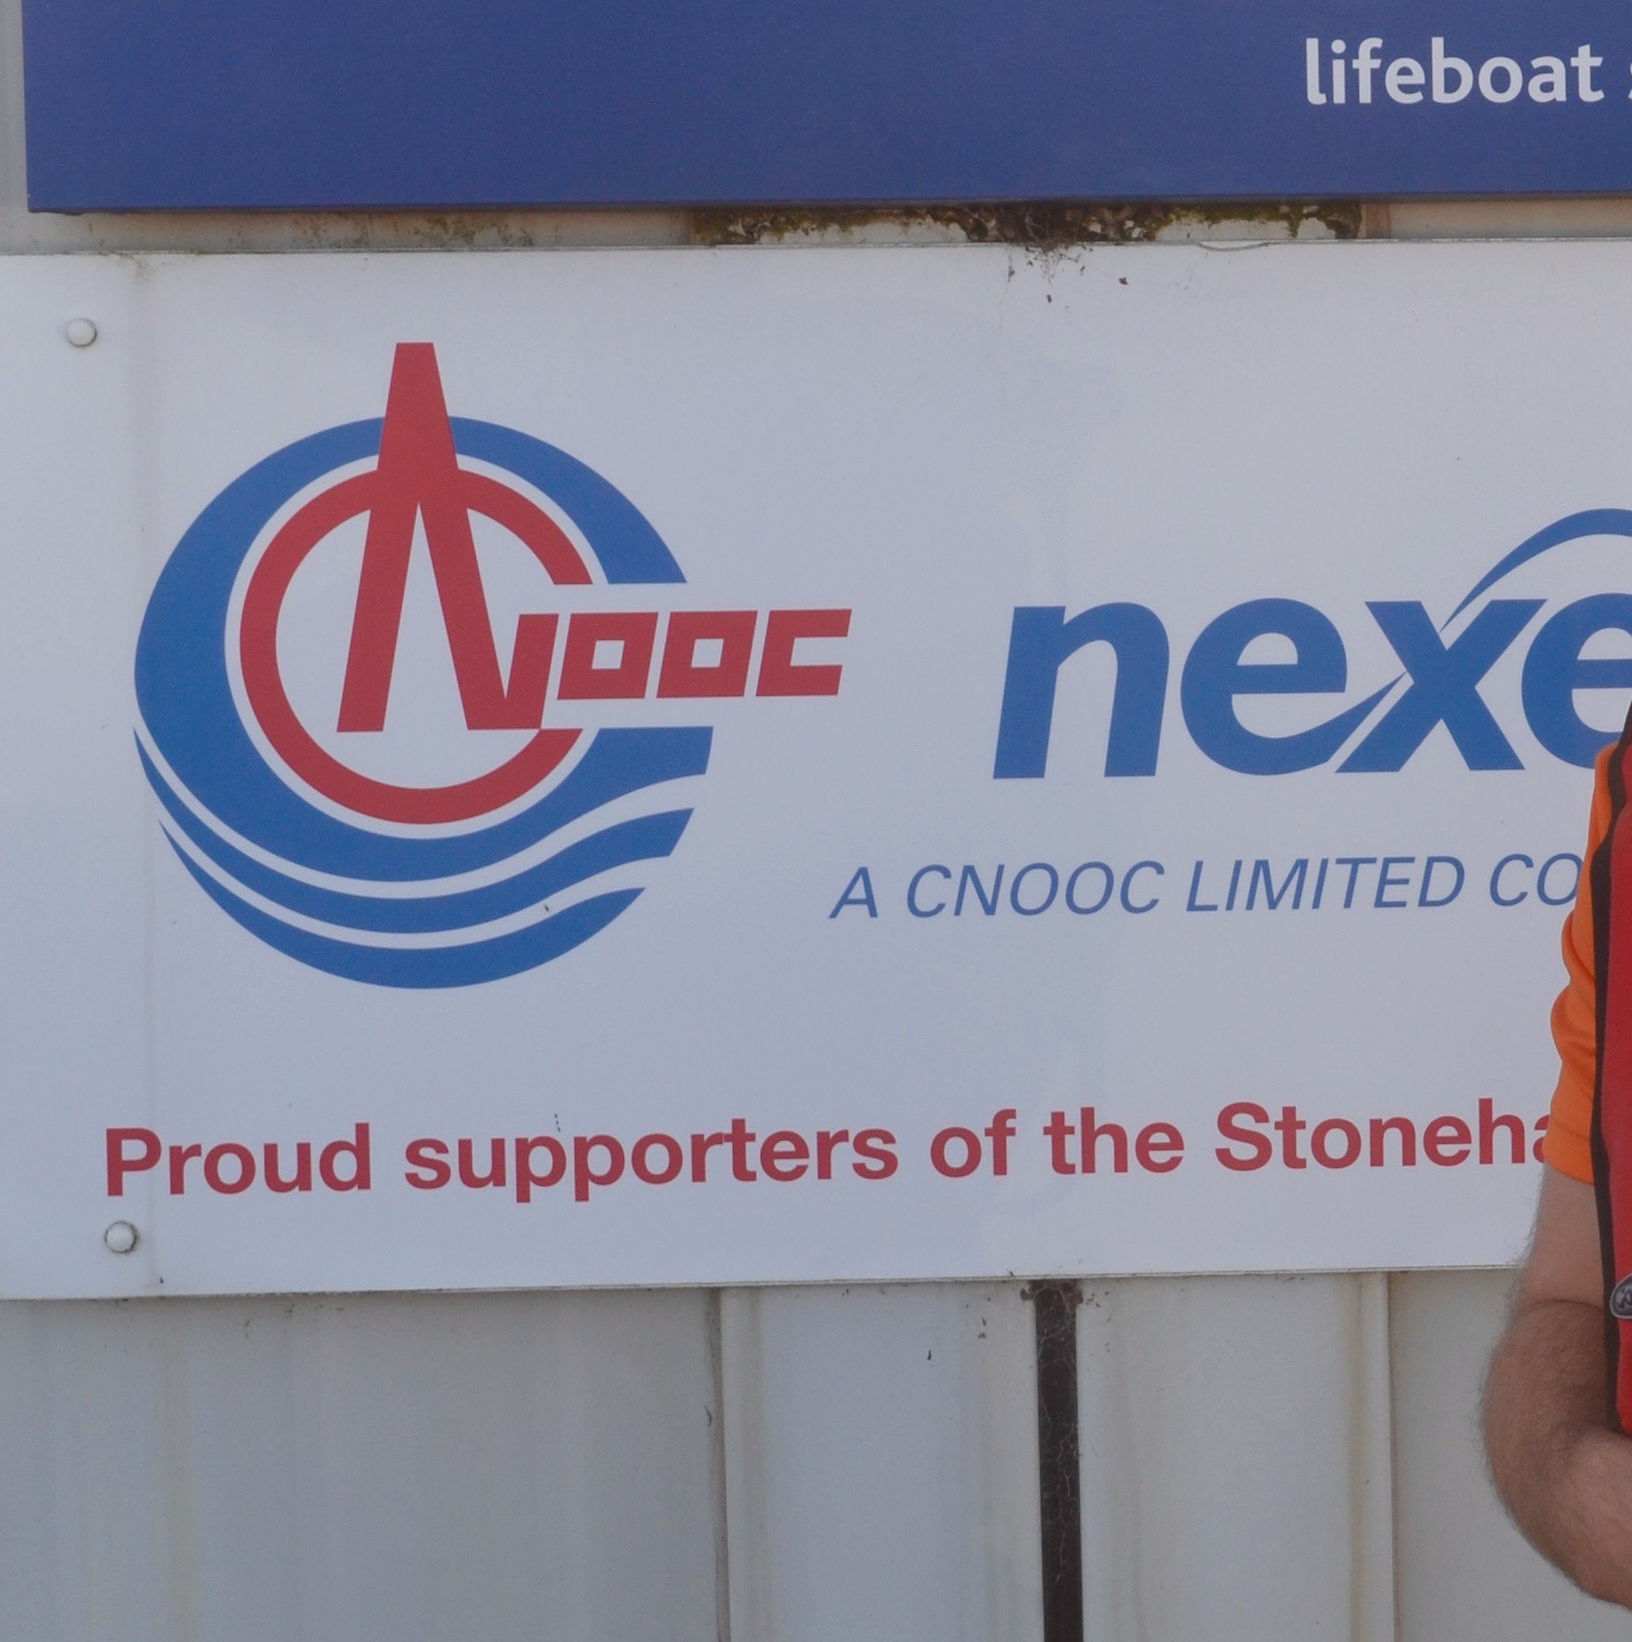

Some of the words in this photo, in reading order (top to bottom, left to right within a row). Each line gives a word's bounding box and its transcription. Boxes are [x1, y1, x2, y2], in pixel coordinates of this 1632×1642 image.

[1304, 37, 1605, 105] lifeboat
[829, 865, 879, 919] A
[905, 860, 1165, 917] CNOOC
[1184, 855, 1466, 912] LIMITED
[105, 1122, 372, 1197] Proud
[403, 1117, 899, 1204] supporters
[929, 1108, 1017, 1178] of
[1042, 1106, 1185, 1175] the
